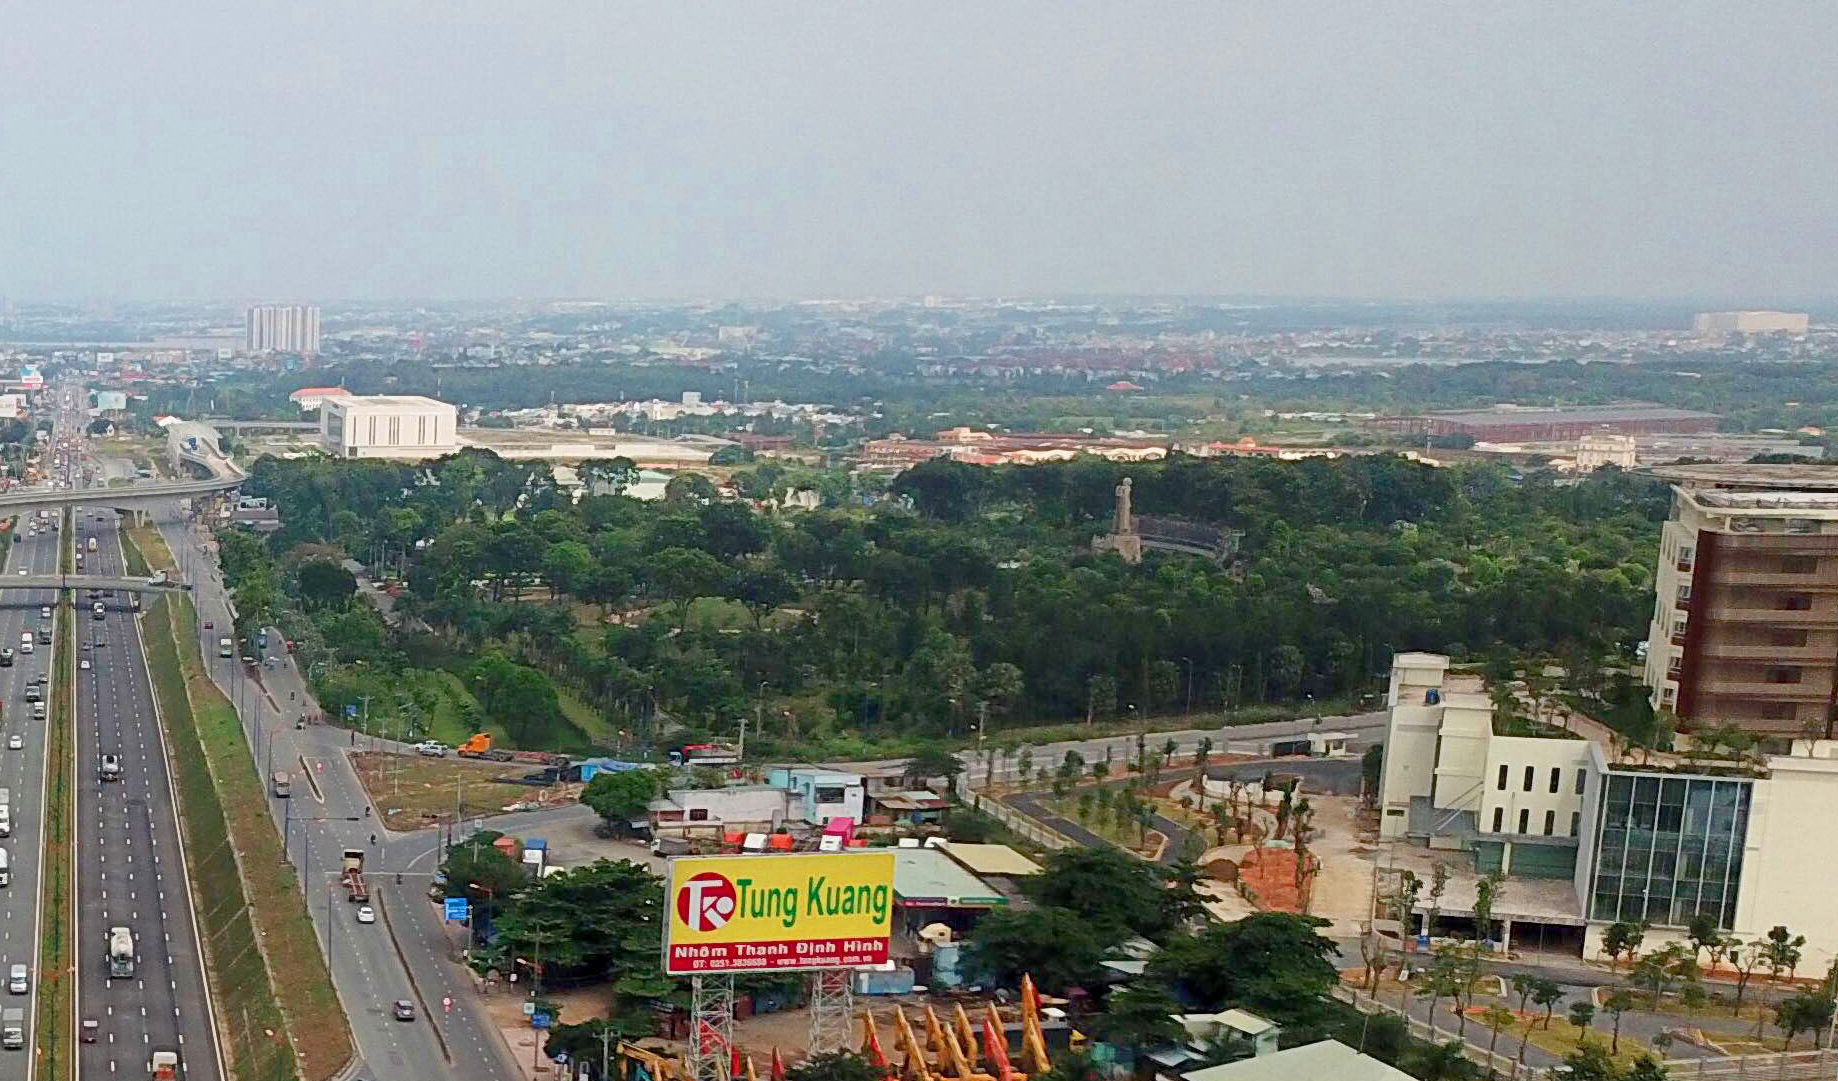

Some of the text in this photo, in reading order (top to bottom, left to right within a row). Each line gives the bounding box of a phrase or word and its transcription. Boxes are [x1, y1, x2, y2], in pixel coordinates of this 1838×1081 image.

[737, 876, 888, 928] Tung Kuang
[675, 939, 883, 958] Nhôm Thanh Định Hình
